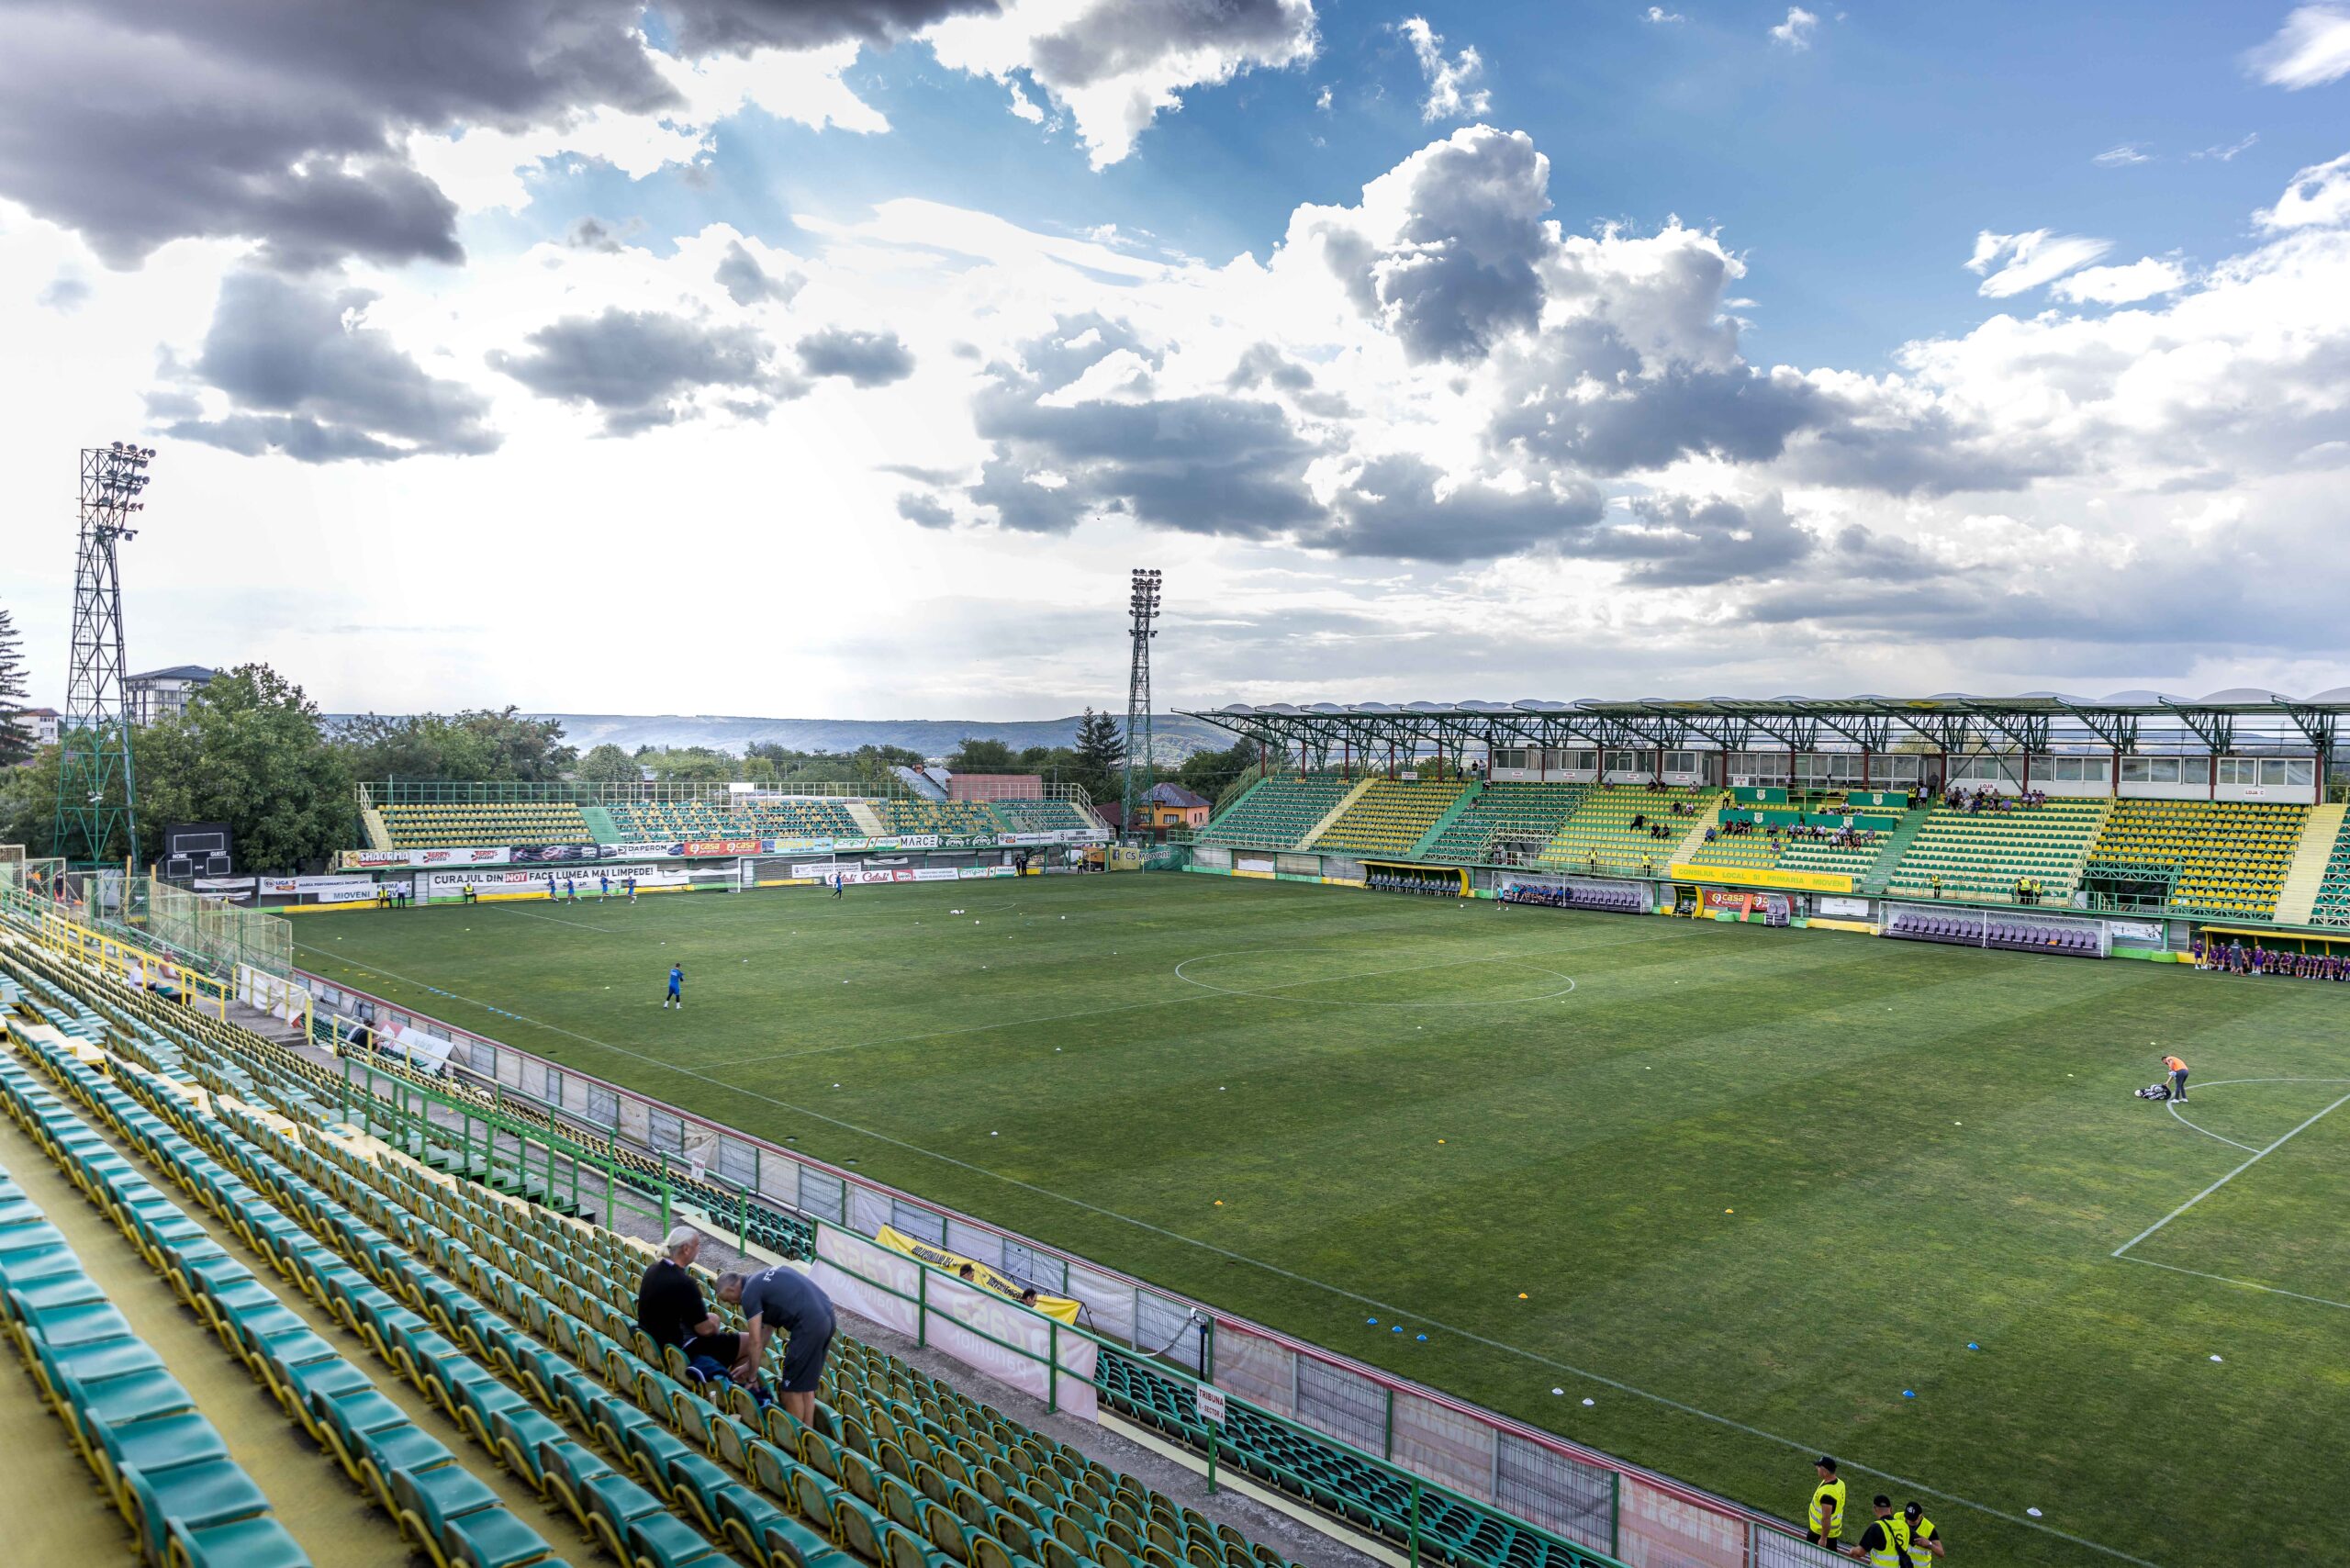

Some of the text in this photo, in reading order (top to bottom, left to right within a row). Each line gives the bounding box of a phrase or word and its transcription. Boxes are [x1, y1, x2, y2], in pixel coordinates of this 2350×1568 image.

[360, 851, 409, 861] SHAORMA
[1125, 850, 1170, 862] CS Mioveni
[434, 874, 484, 884] CURAJUL
[487, 874, 504, 882] DIN
[529, 872, 554, 880] FACE
[556, 869, 588, 879] LUMEA
[592, 868, 610, 878] MAI
[611, 868, 654, 877] LIMPEDE!
[1678, 868, 1716, 878] CONSILIUL
[1722, 872, 1746, 880] LOCAL
[1767, 875, 1805, 884] PRIMARIA
[1812, 878, 1845, 888] MIOVENI
[333, 890, 371, 900] MIOVENI
[1722, 893, 1744, 902] casa
[1198, 1388, 1225, 1407] TRIBUNA
